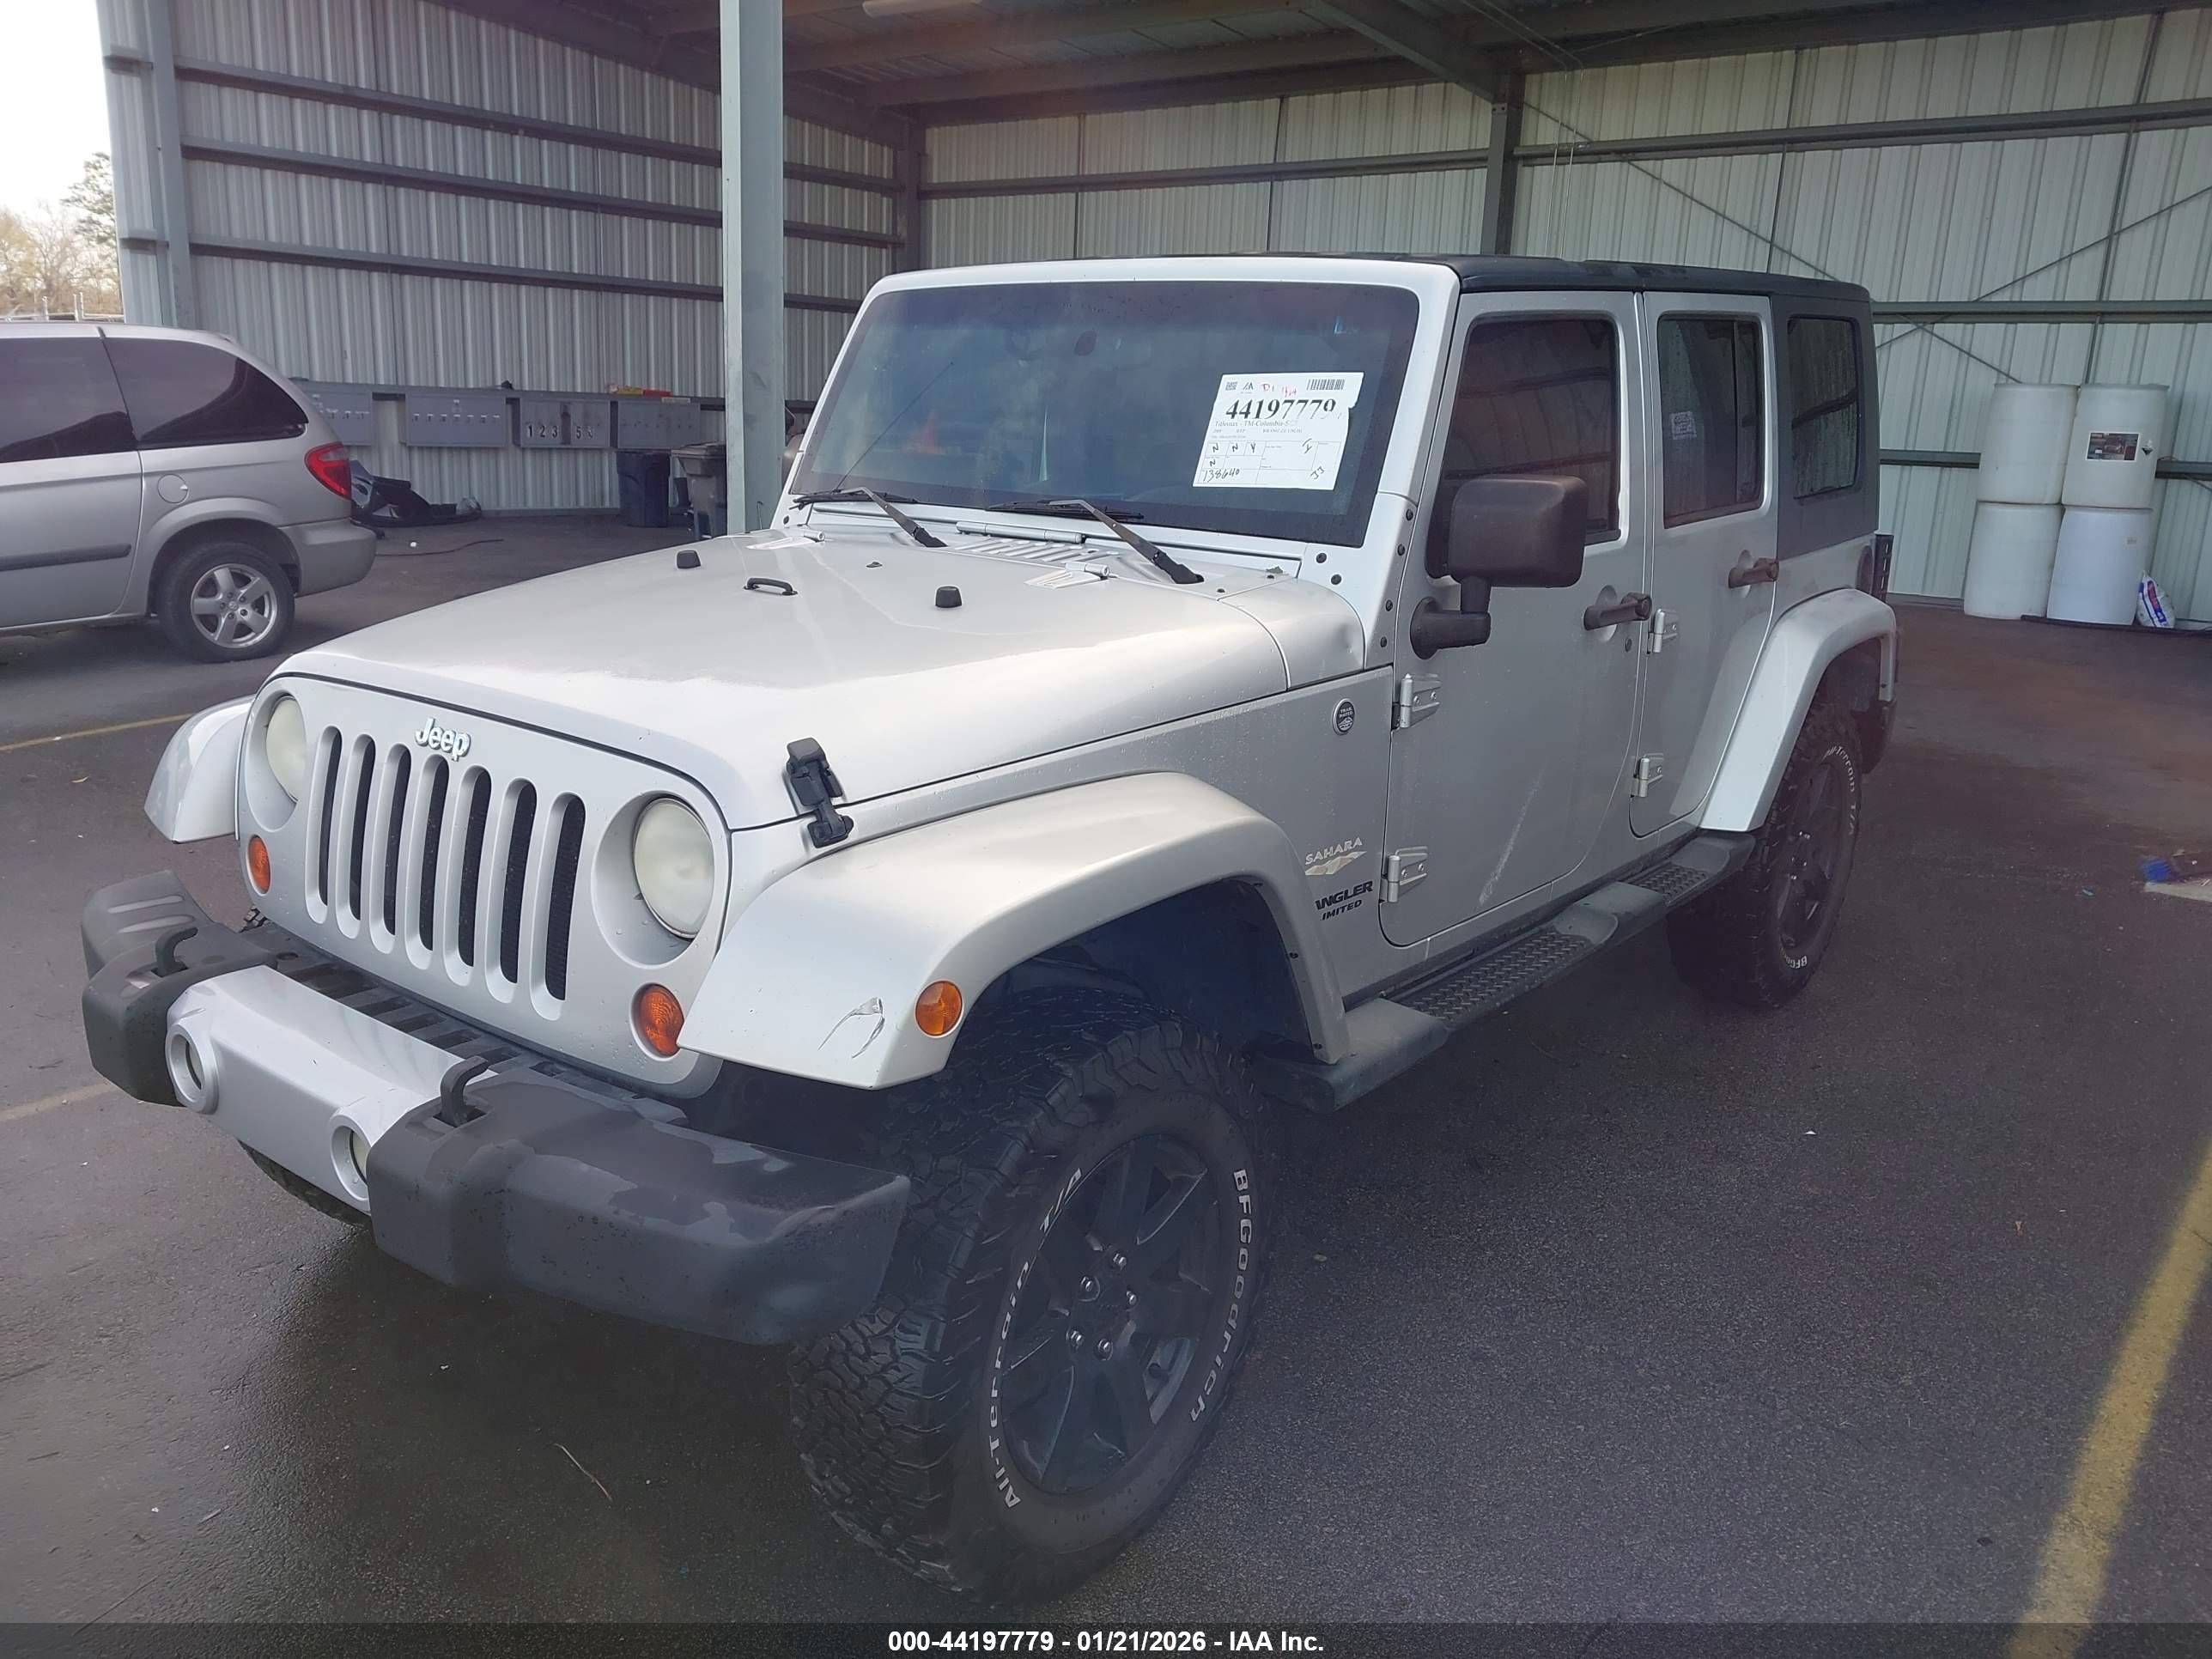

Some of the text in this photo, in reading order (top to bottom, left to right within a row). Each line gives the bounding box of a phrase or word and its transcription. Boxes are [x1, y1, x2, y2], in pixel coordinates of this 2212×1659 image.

[1225, 398, 1336, 420] 44197779
[527, 425, 533, 438] 1
[539, 425, 545, 438] 2
[415, 717, 471, 762] Jeep
[1304, 836, 1363, 866] SAHARA
[1188, 1168, 1254, 1422] BFGoodrich
